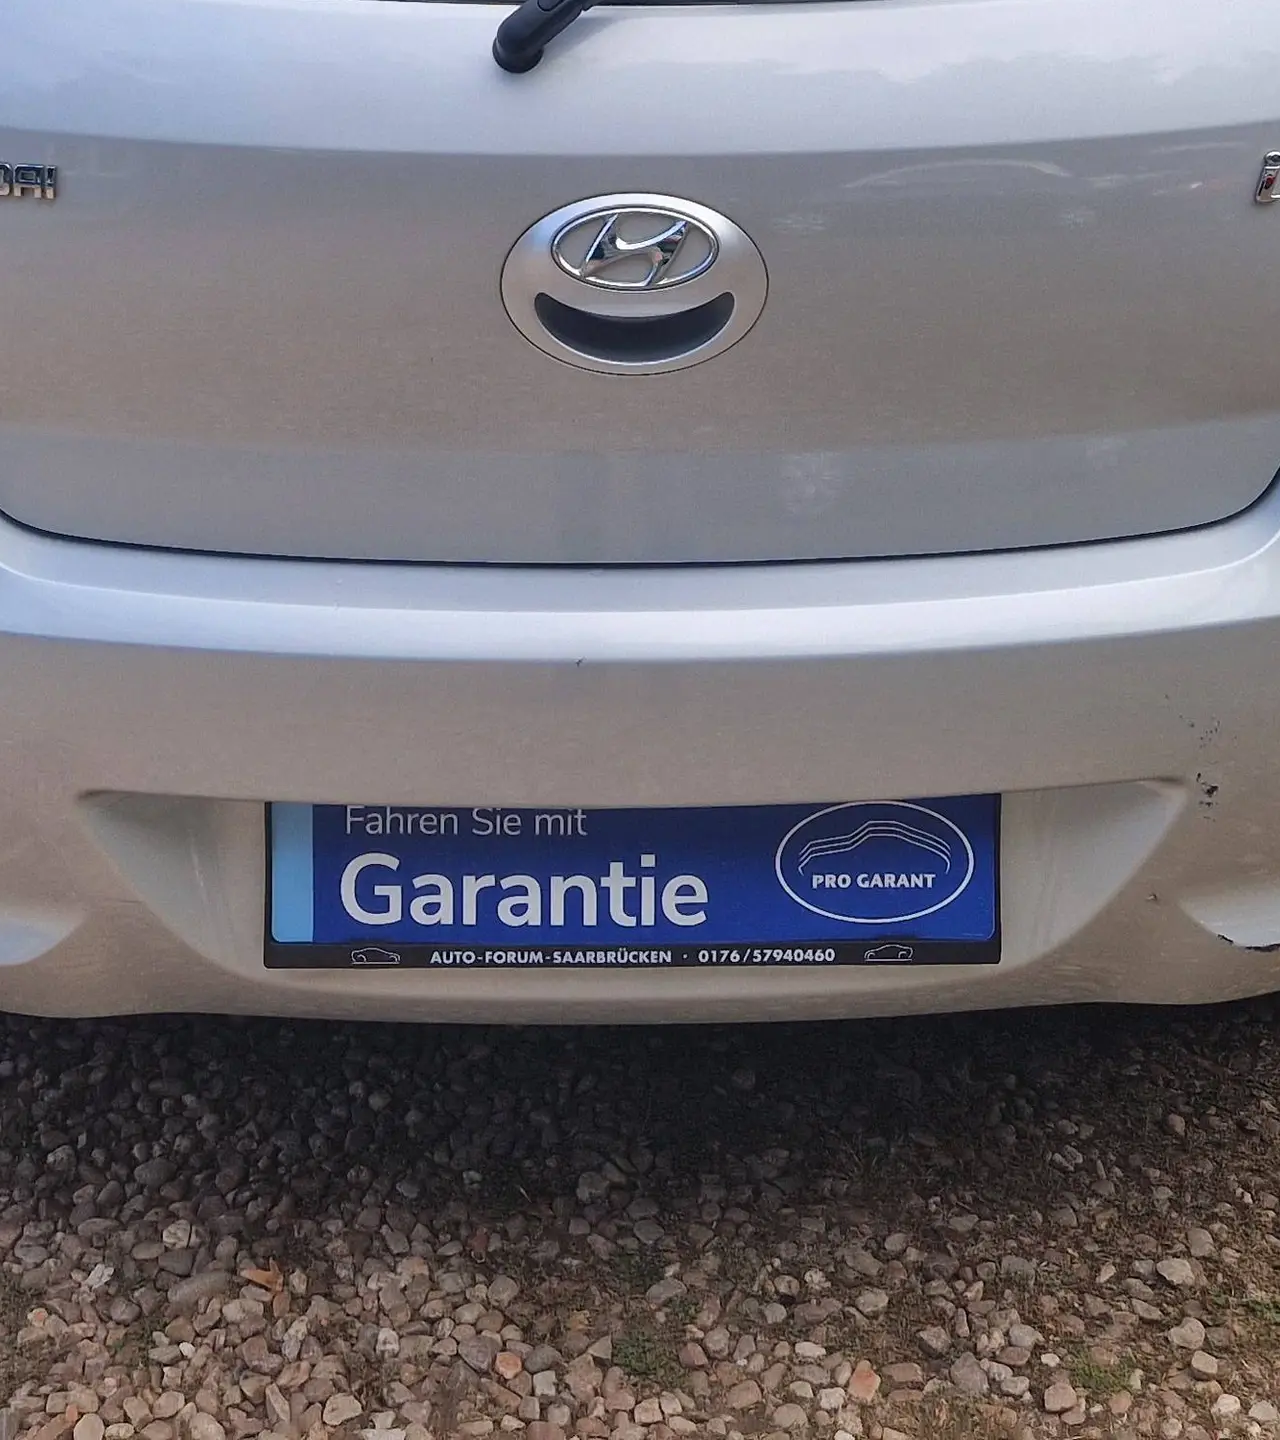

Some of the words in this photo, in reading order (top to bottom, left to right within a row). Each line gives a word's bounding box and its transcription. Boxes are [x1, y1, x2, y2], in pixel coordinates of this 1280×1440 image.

[345, 805, 458, 835] Fahren
[472, 808, 522, 836] Sie
[534, 809, 588, 836] mit
[340, 852, 708, 927] Garantie
[812, 874, 851, 889] PRO
[857, 873, 936, 888] GARANT
[430, 948, 671, 964] AUTO-FORUM-SAARBRÜCKEN
[698, 948, 835, 963] 0176/57940460
